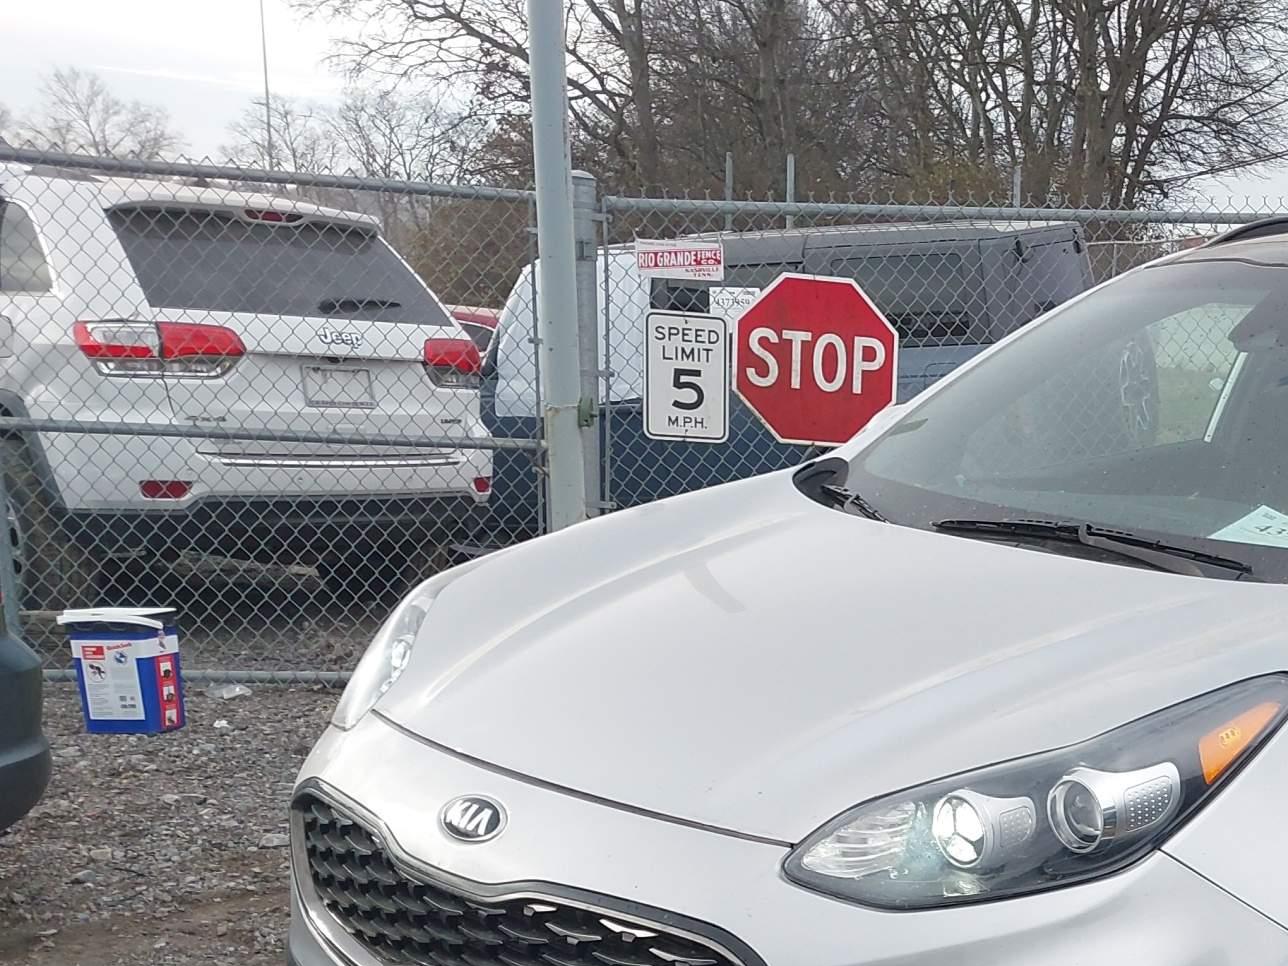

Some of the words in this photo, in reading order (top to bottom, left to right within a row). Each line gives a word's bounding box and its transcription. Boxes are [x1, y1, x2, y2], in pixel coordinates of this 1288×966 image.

[638, 252, 655, 267] RIO
[656, 250, 697, 266] GRANDE
[696, 250, 720, 261] FENCE
[319, 326, 364, 350] Jeep
[654, 325, 721, 345] SPEED
[662, 344, 714, 363] LIMIT
[745, 326, 887, 395] STOP
[671, 367, 705, 411] 5
[667, 415, 708, 430] M.P.H.
